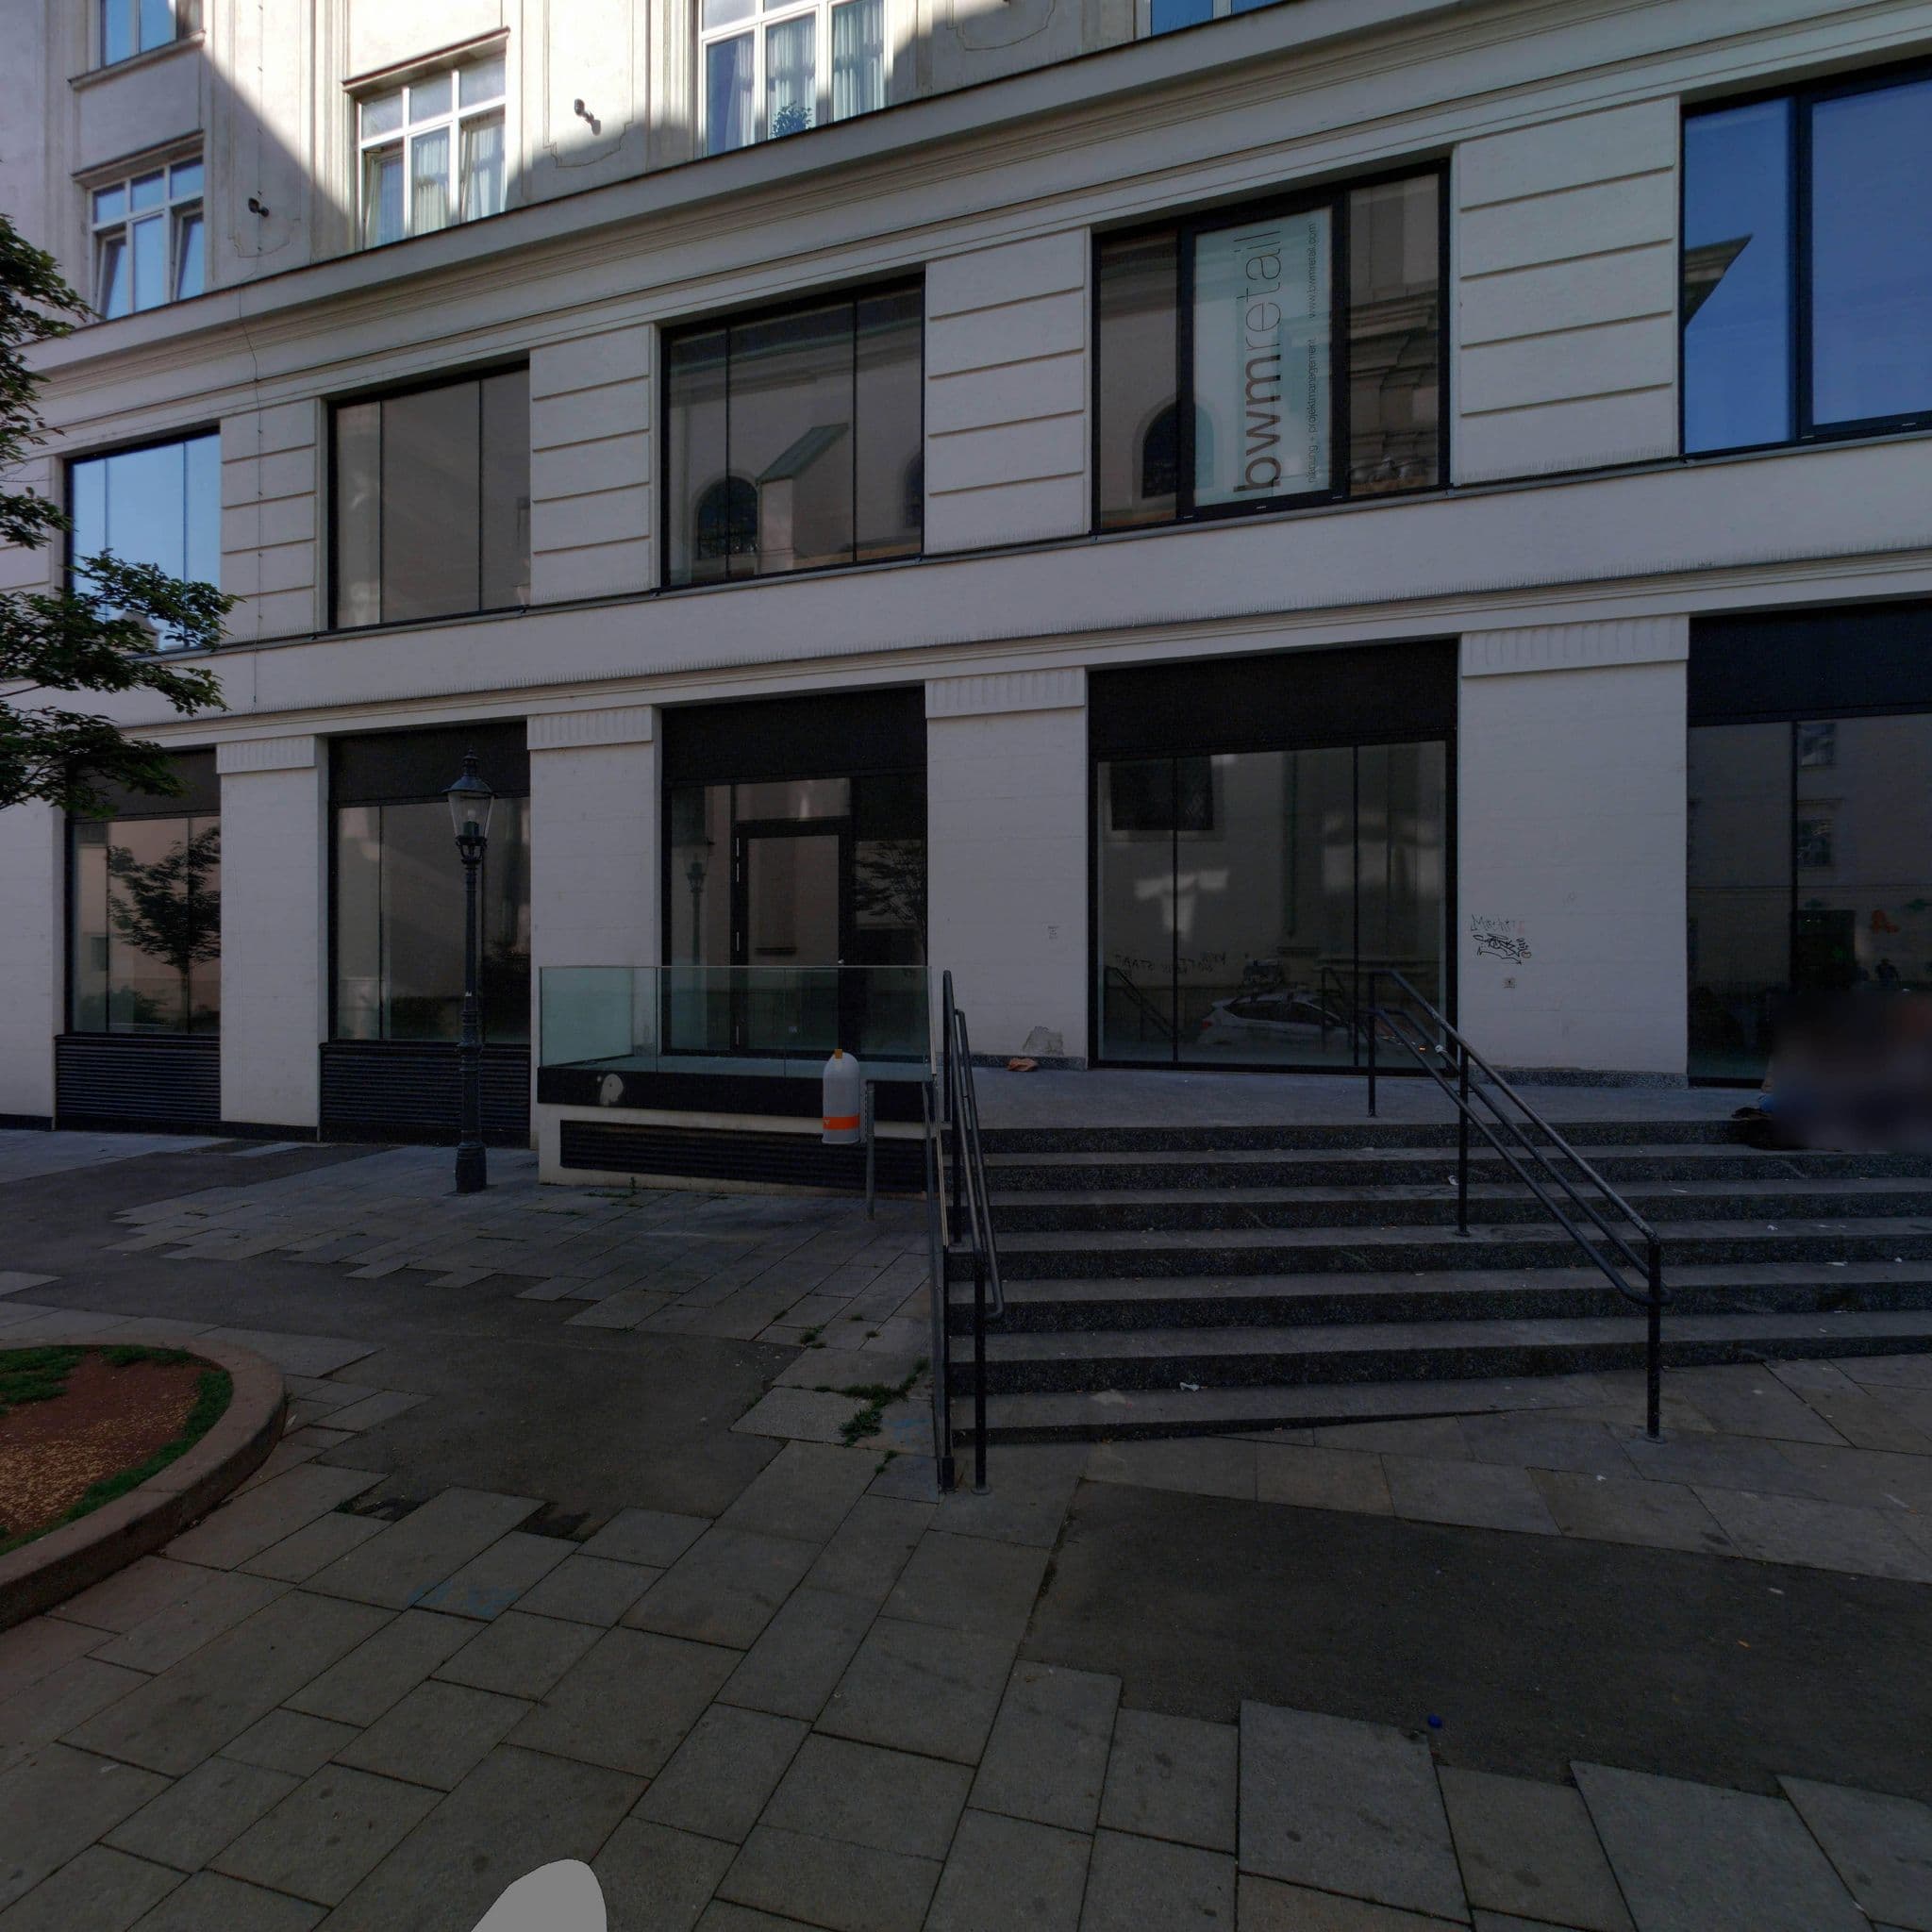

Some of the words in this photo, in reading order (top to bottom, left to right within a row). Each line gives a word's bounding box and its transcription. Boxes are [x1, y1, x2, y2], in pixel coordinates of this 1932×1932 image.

[1306, 223, 1318, 320] www.bwmretail.com
[1233, 230, 1282, 492] bwmretail
[1306, 337, 1319, 433] projektmanagement
